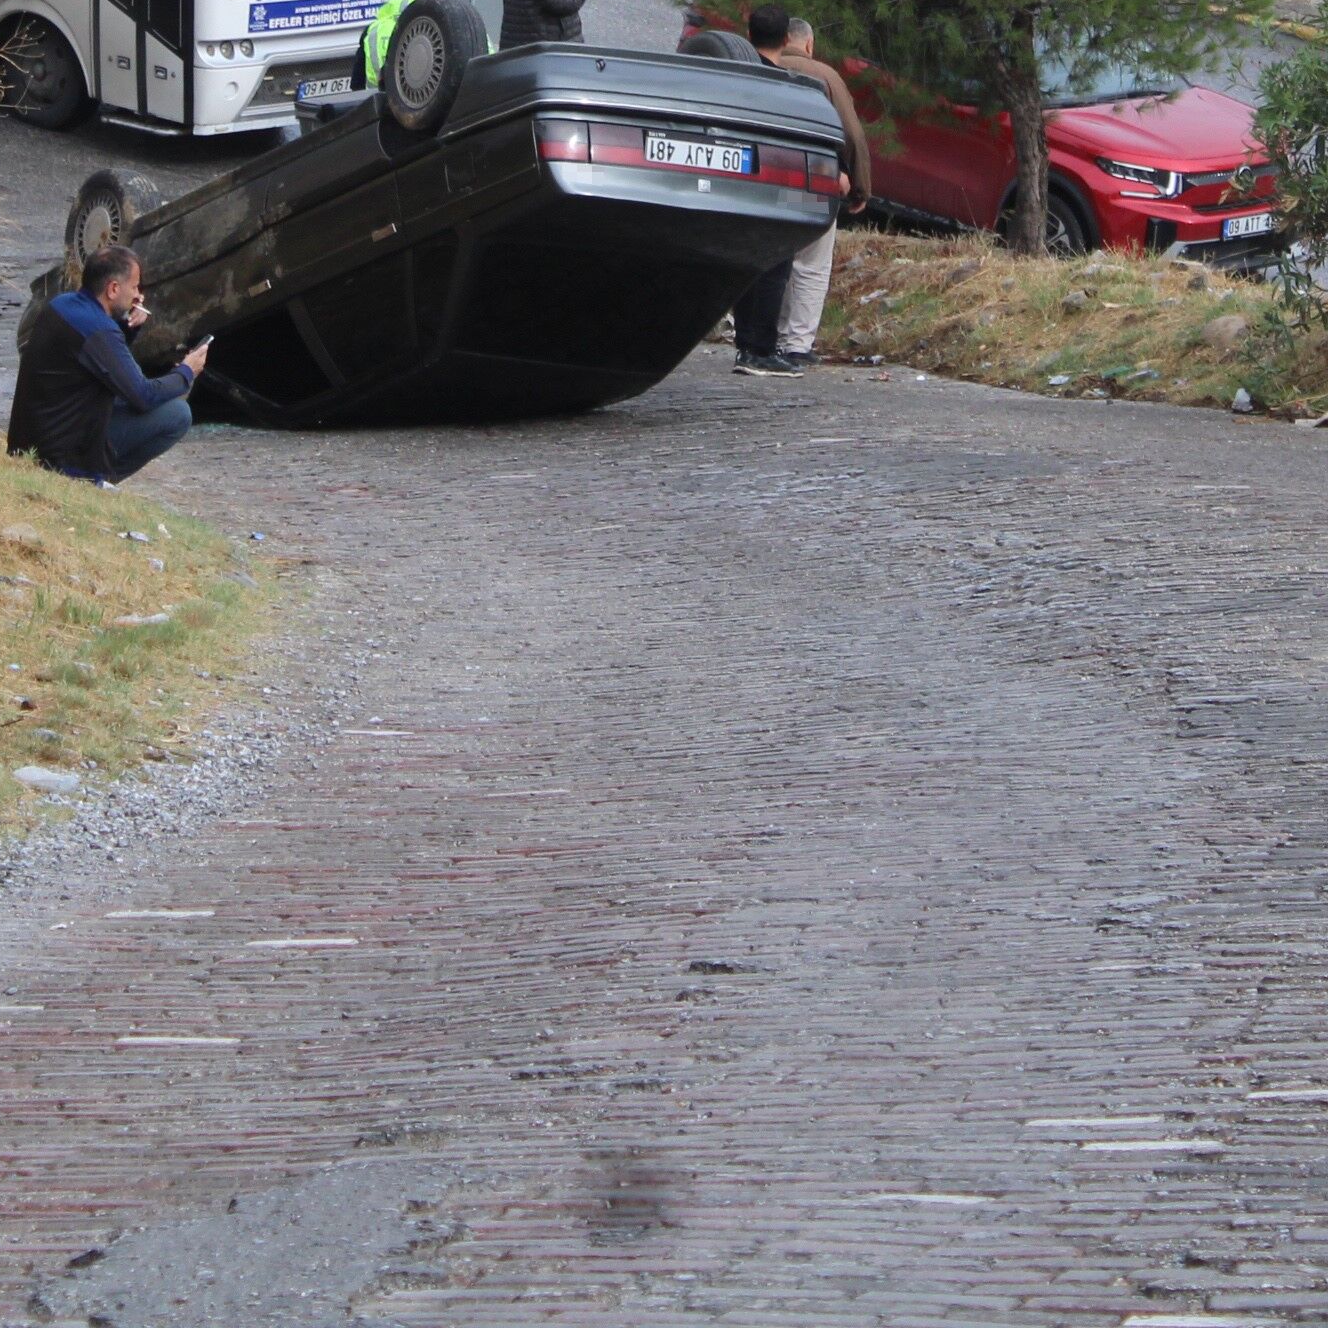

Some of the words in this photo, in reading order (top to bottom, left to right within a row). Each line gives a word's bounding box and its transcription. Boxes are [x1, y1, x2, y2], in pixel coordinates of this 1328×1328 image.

[268, 16, 303, 30] EFELER
[303, 10, 341, 28] ŞEHİRİÇİ
[342, 8, 363, 21] ÖZEL
[305, 83, 317, 95] 09
[320, 82, 328, 93] M
[331, 79, 350, 92] 061
[650, 140, 676, 162] 481
[685, 145, 714, 167] AJY
[722, 150, 740, 170] 09
[1229, 221, 1240, 234] 09
[1244, 216, 1260, 231] ATT
